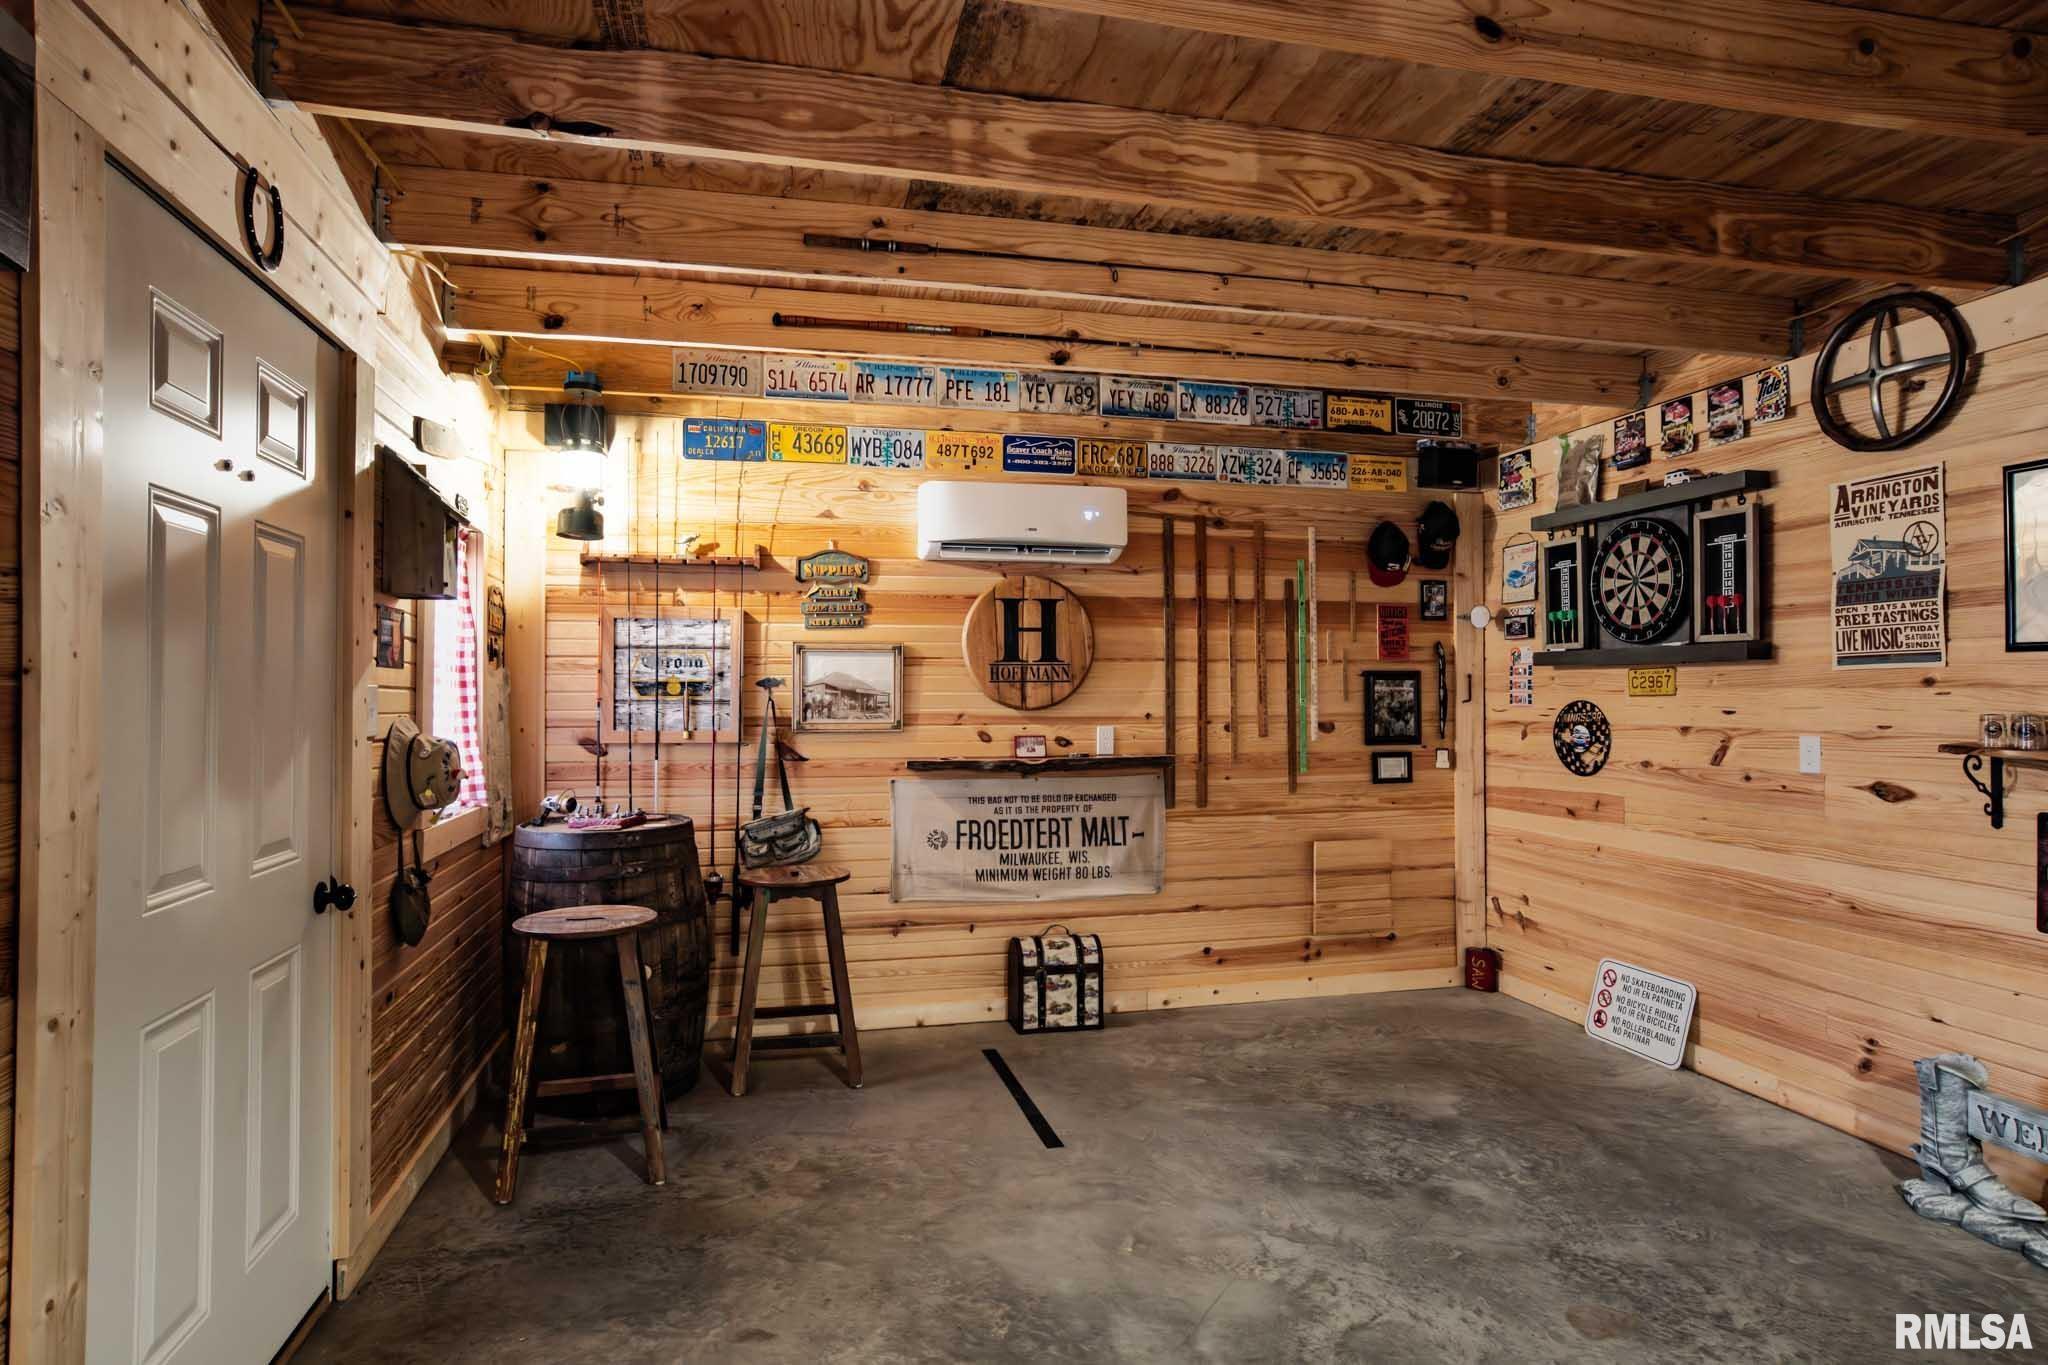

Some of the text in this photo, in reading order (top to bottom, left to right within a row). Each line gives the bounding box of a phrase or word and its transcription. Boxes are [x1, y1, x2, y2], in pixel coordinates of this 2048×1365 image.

[678, 362, 748, 387] 1709790
[768, 369, 847, 393] S14 6574
[856, 373, 933, 398] AR 17777
[946, 379, 1010, 402] PFE 181
[1026, 383, 1095, 406] YEY 489
[1758, 375, 1781, 401] Tide
[1109, 389, 1169, 412] YEY 489
[1180, 392, 1248, 416] CX 88328
[1255, 395, 1320, 418] 527 LJE
[793, 433, 844, 455] 43669
[851, 437, 922, 460] WYB 084
[937, 444, 994, 459] 487T692
[1031, 447, 1052, 456] Coach
[1054, 449, 1072, 457] Sales
[1081, 445, 1144, 467] FRC 687
[1150, 454, 1214, 473] 888 3226
[1220, 454, 1280, 478] XZW 324
[1310, 462, 1346, 481] 35656
[1835, 474, 1939, 515] ARRINGTON
[1851, 493, 1939, 518] VINEYARDS
[1888, 506, 1940, 520] TENNESSEE
[803, 562, 863, 578] SUPPLIES
[1835, 606, 1858, 614] OPEN
[1873, 603, 1897, 611] DAYS
[1910, 600, 1938, 608] WEEK
[1835, 608, 1939, 627] FREE TASTINGS
[994, 598, 1064, 662] H
[1835, 627, 1903, 652] LIVE MUSIC
[1904, 624, 1939, 632] FRIDAY
[1905, 632, 1939, 641] SATURDAY
[990, 665, 1071, 681] HOFFMANN
[1631, 674, 1671, 689] C2967
[968, 793, 1117, 805] THIS BAG NOT TO BE SOLD OR EXCHANGED
[993, 804, 1093, 815] AS IT IS THE PROPERTY OF
[956, 817, 1073, 851] FROEDTERT
[1080, 816, 1130, 847] MALT
[1000, 850, 1091, 866] MILWAUKEE, WIS.
[975, 865, 1112, 883] MINIMUM WEIGHT 80 LBS.
[1621, 974, 1686, 1002] NO SKATEBOARDING
[1622, 984, 1683, 1011] NO IR EN PATINETA
[1616, 994, 1679, 1023] NO BICYCLE RIDING
[1618, 1005, 1680, 1034] NO IR EN BICICLETA
[1611, 1015, 1676, 1046] NO ROLLERBLADING
[1612, 1025, 1650, 1046] NO PATINAR
